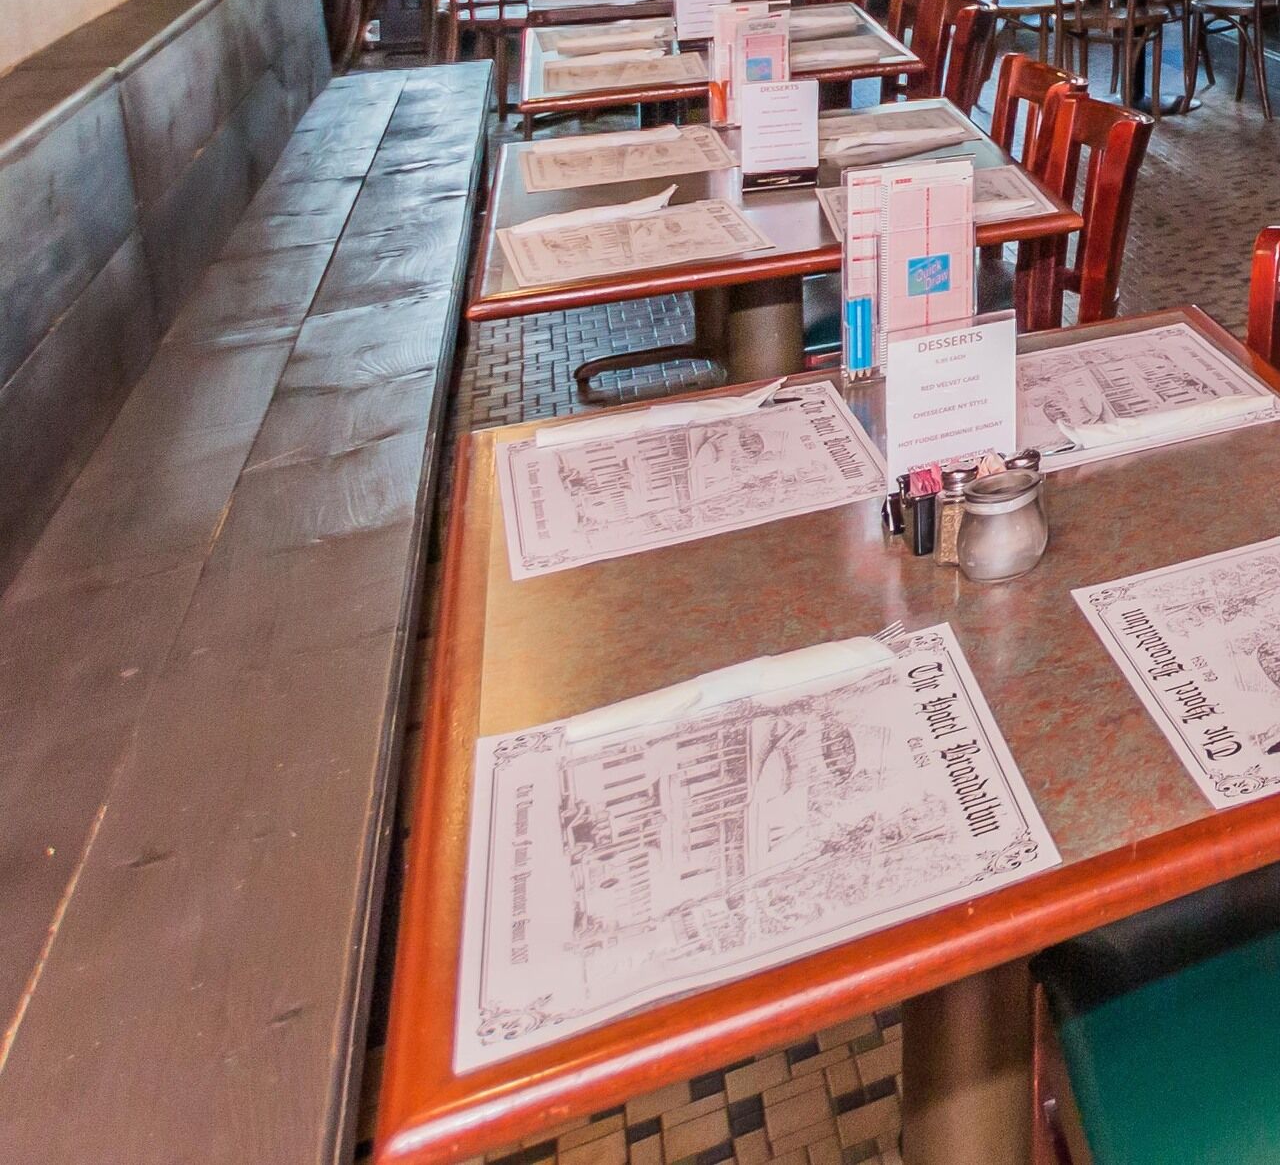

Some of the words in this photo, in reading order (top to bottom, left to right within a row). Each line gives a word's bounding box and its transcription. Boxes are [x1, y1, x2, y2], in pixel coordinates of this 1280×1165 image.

[918, 331, 983, 353] DESSERTS
[937, 378, 962, 389] VELVET
[963, 374, 981, 383] CAKE
[913, 404, 956, 420] CHEESECAKE
[958, 402, 968, 410] NY
[969, 398, 988, 408] STYLE
[898, 440, 914, 449] HOT
[915, 435, 939, 445] FUDGE
[940, 426, 974, 440] BROWNIE
[908, 662, 944, 692] The
[1165, 680, 1224, 724] Hotel
[914, 693, 967, 739] Hotel
[1203, 725, 1242, 761] The
